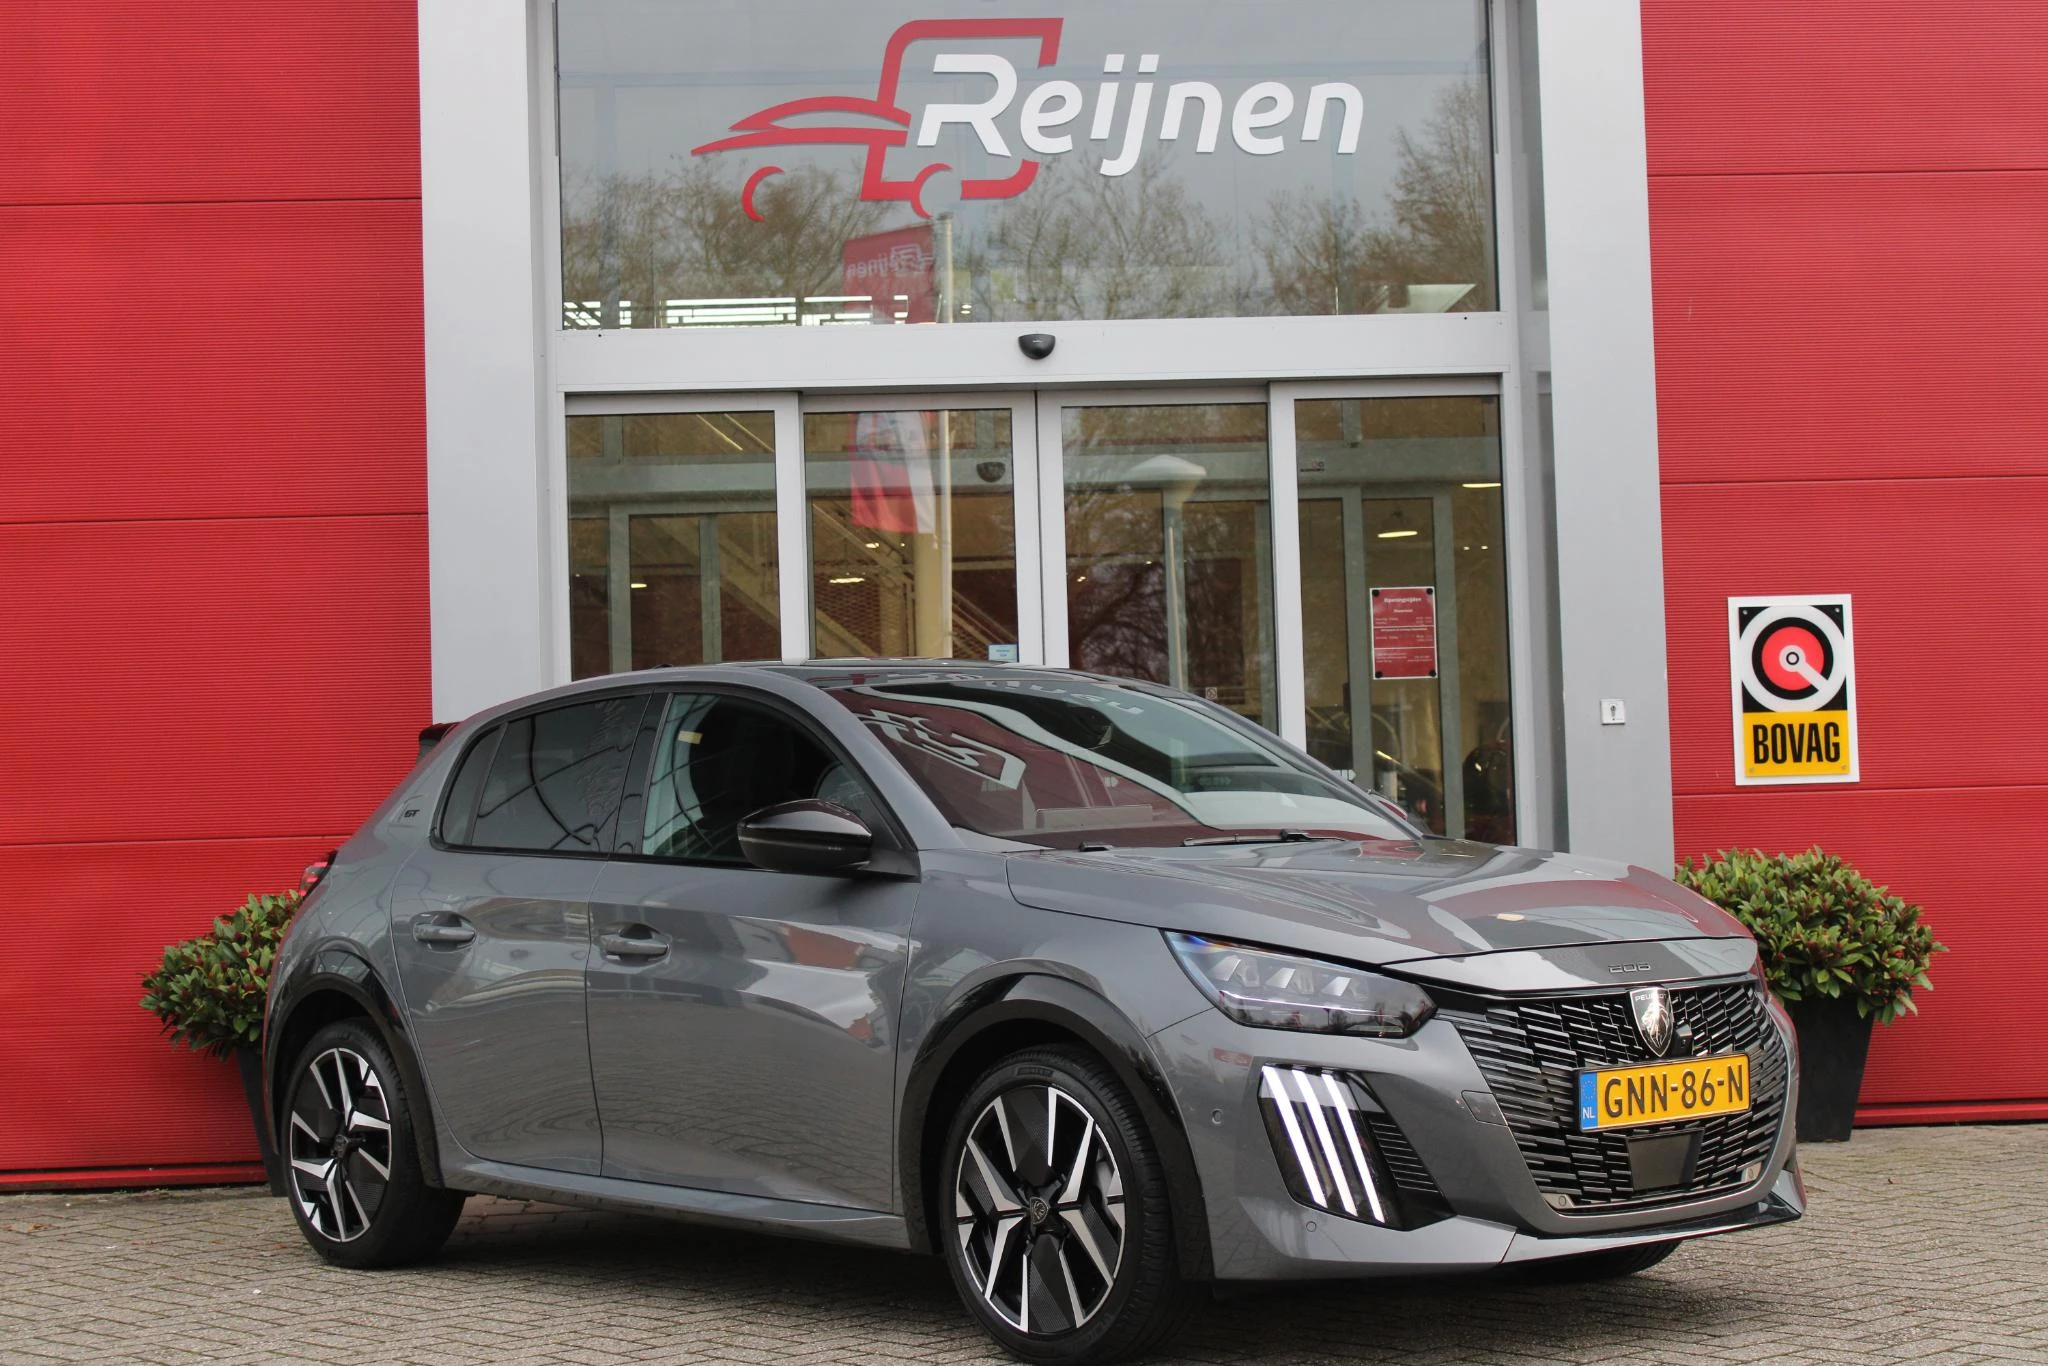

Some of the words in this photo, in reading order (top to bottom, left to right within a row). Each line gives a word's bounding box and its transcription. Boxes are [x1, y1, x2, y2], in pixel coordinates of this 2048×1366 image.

[917, 54, 1364, 176] Reijnen
[1753, 722, 1841, 764] BOVAG
[1634, 993, 1667, 1002] PEUOT
[1604, 1064, 1744, 1118] GNN-86-N
[1582, 1106, 1595, 1119] NL
